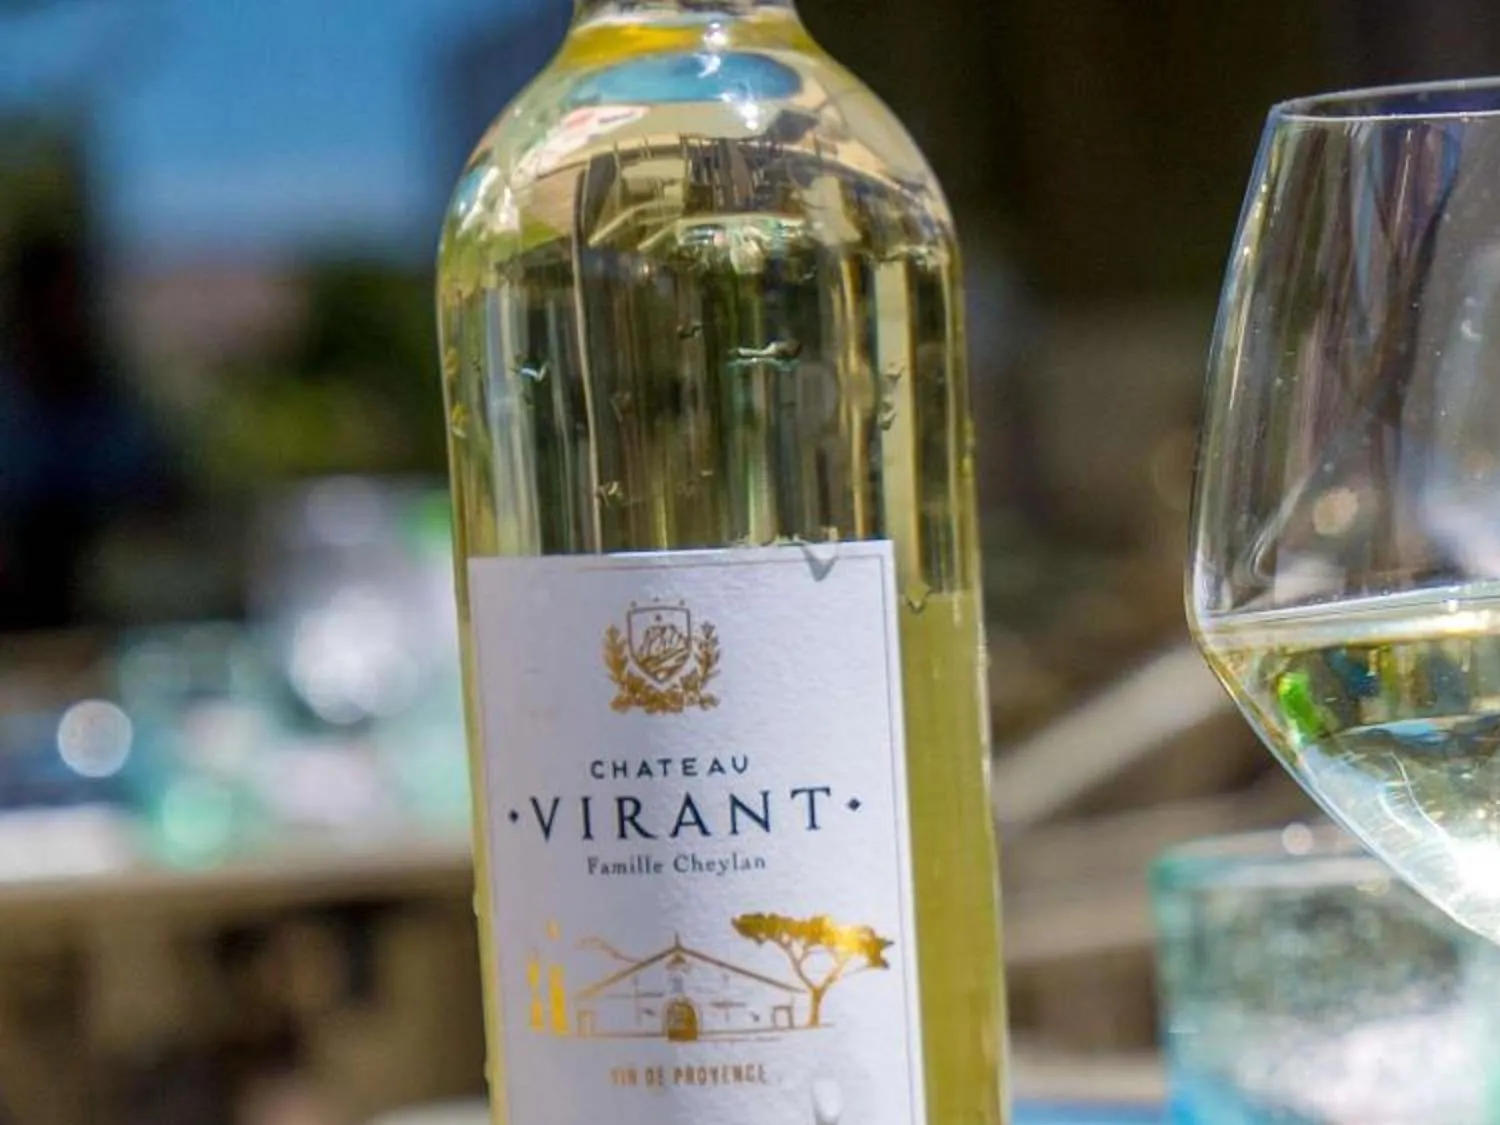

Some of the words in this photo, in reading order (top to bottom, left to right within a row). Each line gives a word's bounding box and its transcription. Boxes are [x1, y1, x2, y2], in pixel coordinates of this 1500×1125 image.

[590, 755, 749, 780] CHATEAU
[529, 786, 831, 843] VIRANT
[587, 855, 664, 876] Famille
[673, 852, 766, 878] Cheylan
[645, 1065, 664, 1087] DE
[673, 1063, 768, 1087] PROVENCE
